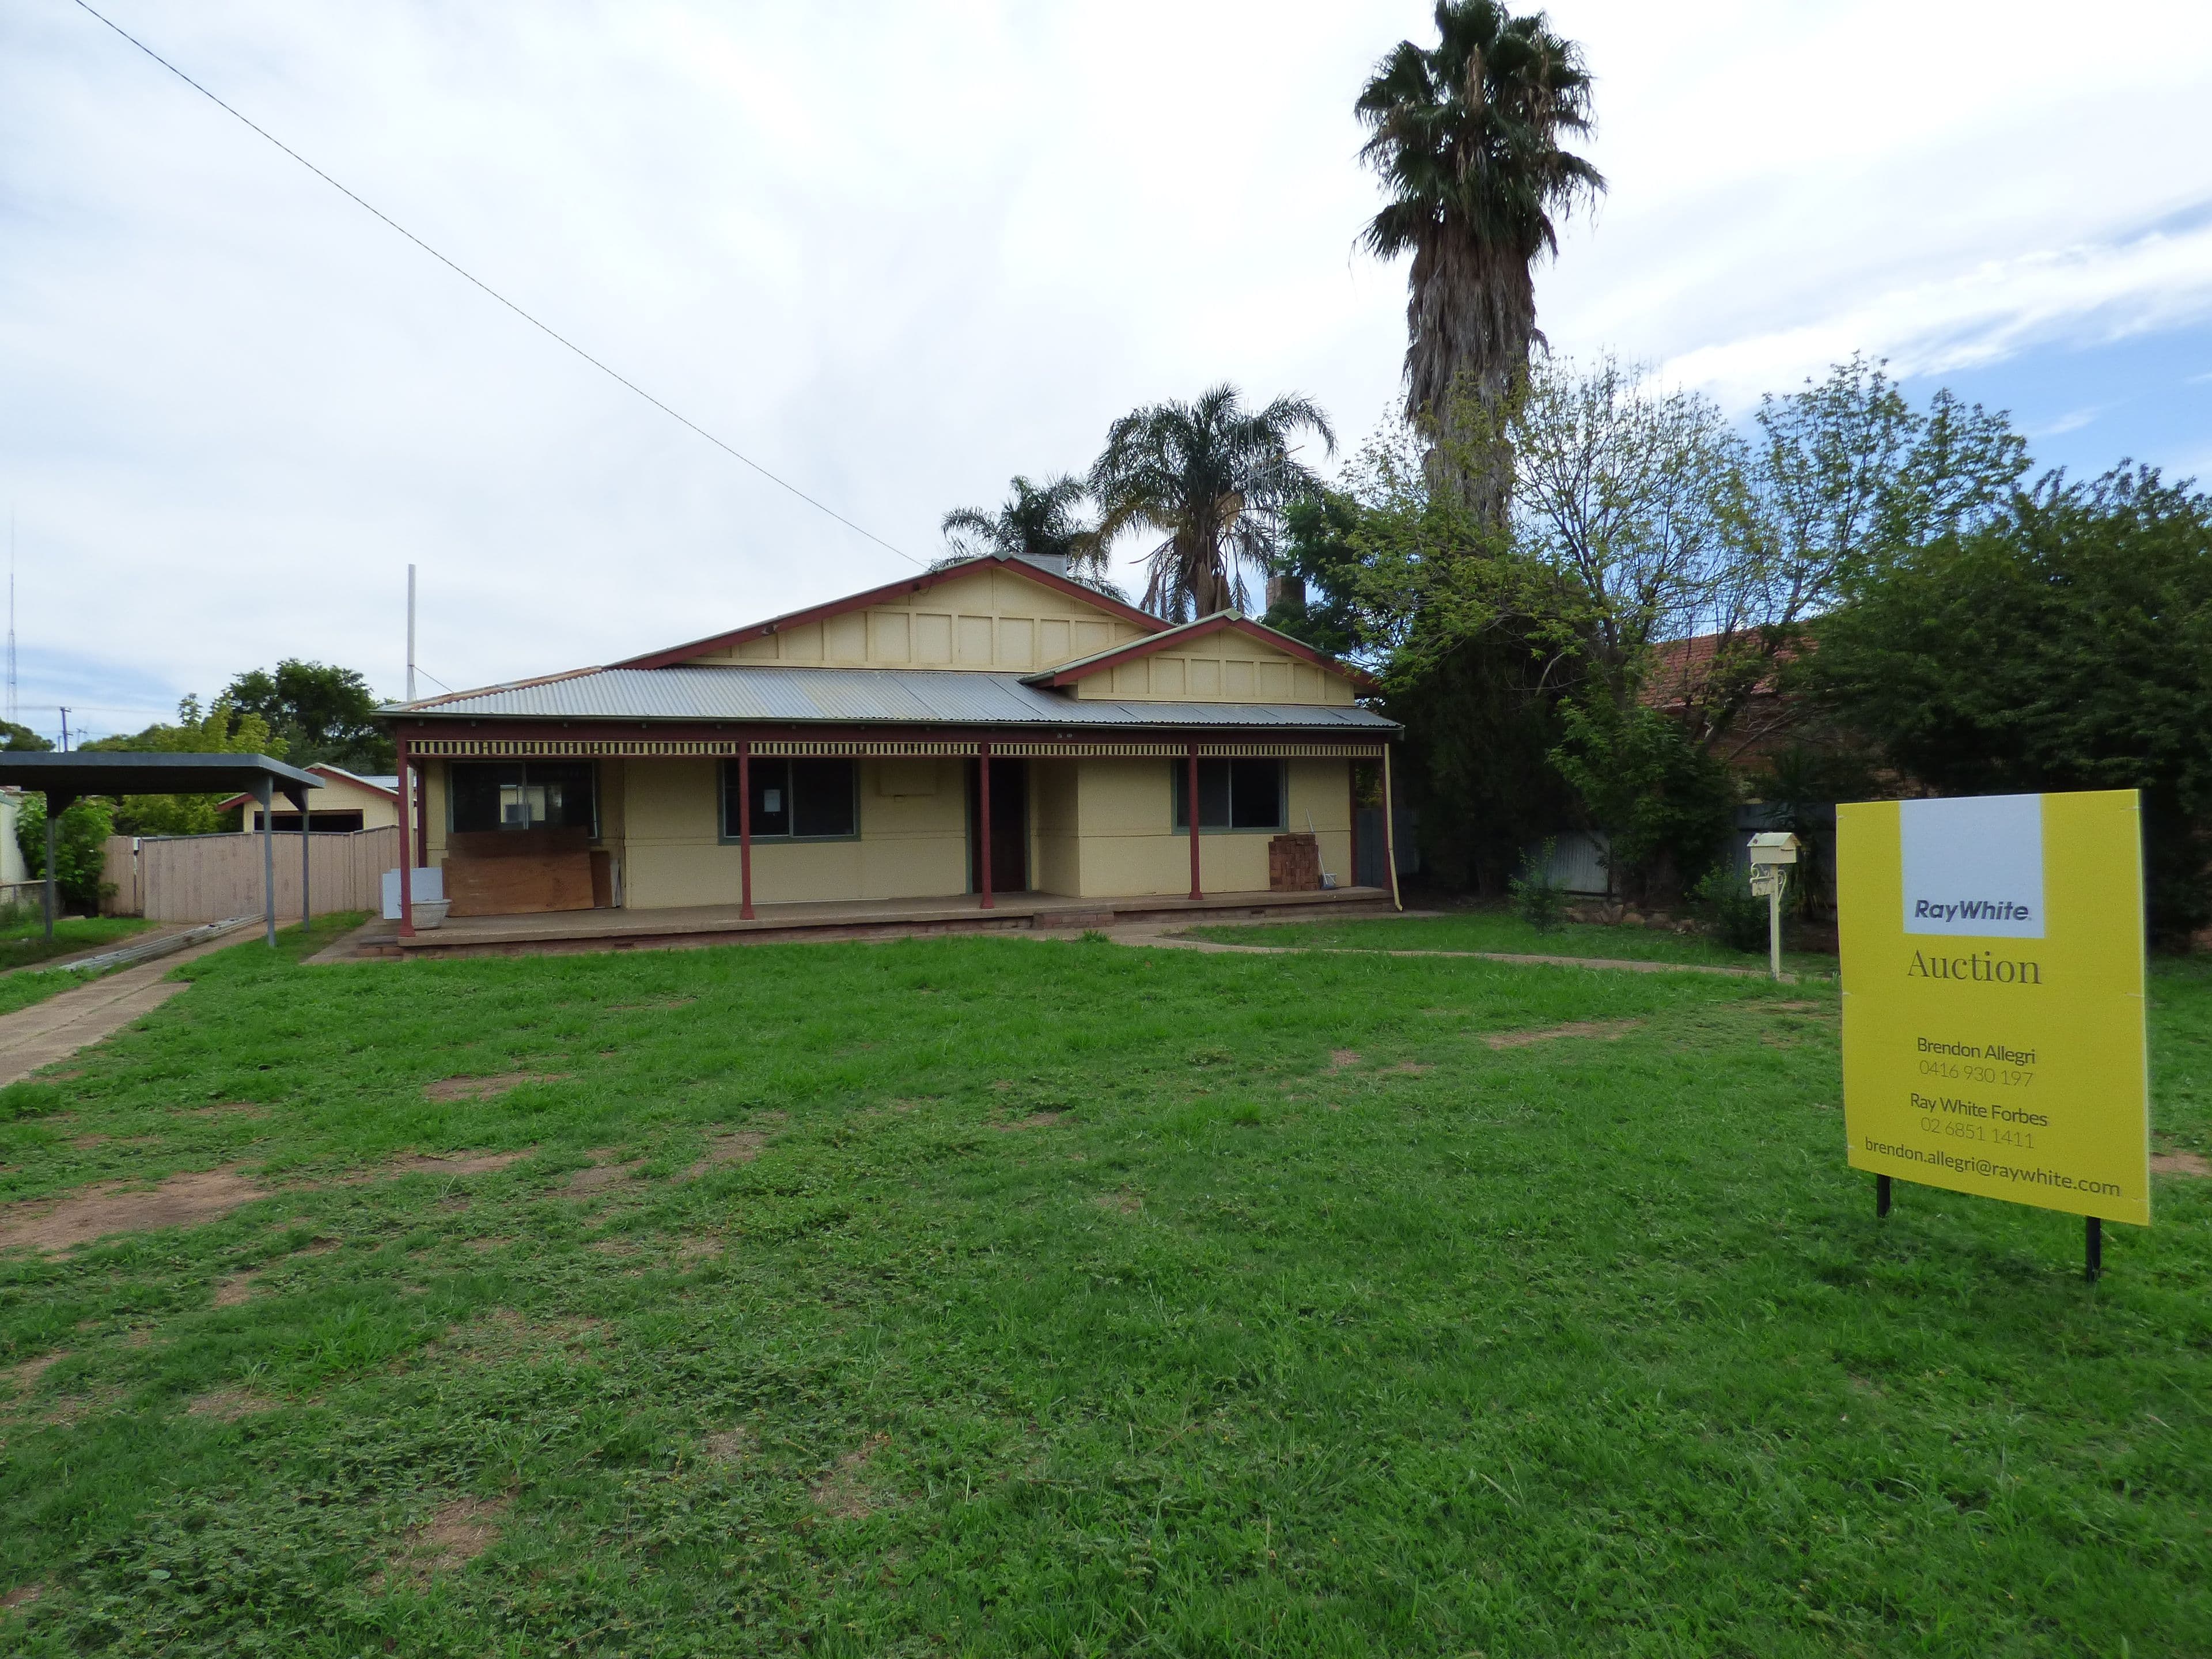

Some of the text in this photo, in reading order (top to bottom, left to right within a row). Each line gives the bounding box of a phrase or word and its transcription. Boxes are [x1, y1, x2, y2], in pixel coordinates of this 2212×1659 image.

[1915, 900, 2028, 922] RayWhite
[1908, 950, 2041, 984] Auction
[1918, 1037, 2035, 1066] Brendon Allegri
[1919, 1060, 2033, 1087] 0416 930 197
[1911, 1093, 2049, 1126] Ray White Forbes
[1921, 1118, 2035, 1149] 02 6851 1411
[1865, 1137, 2120, 1196] brendon.allegri@raywhite.com
